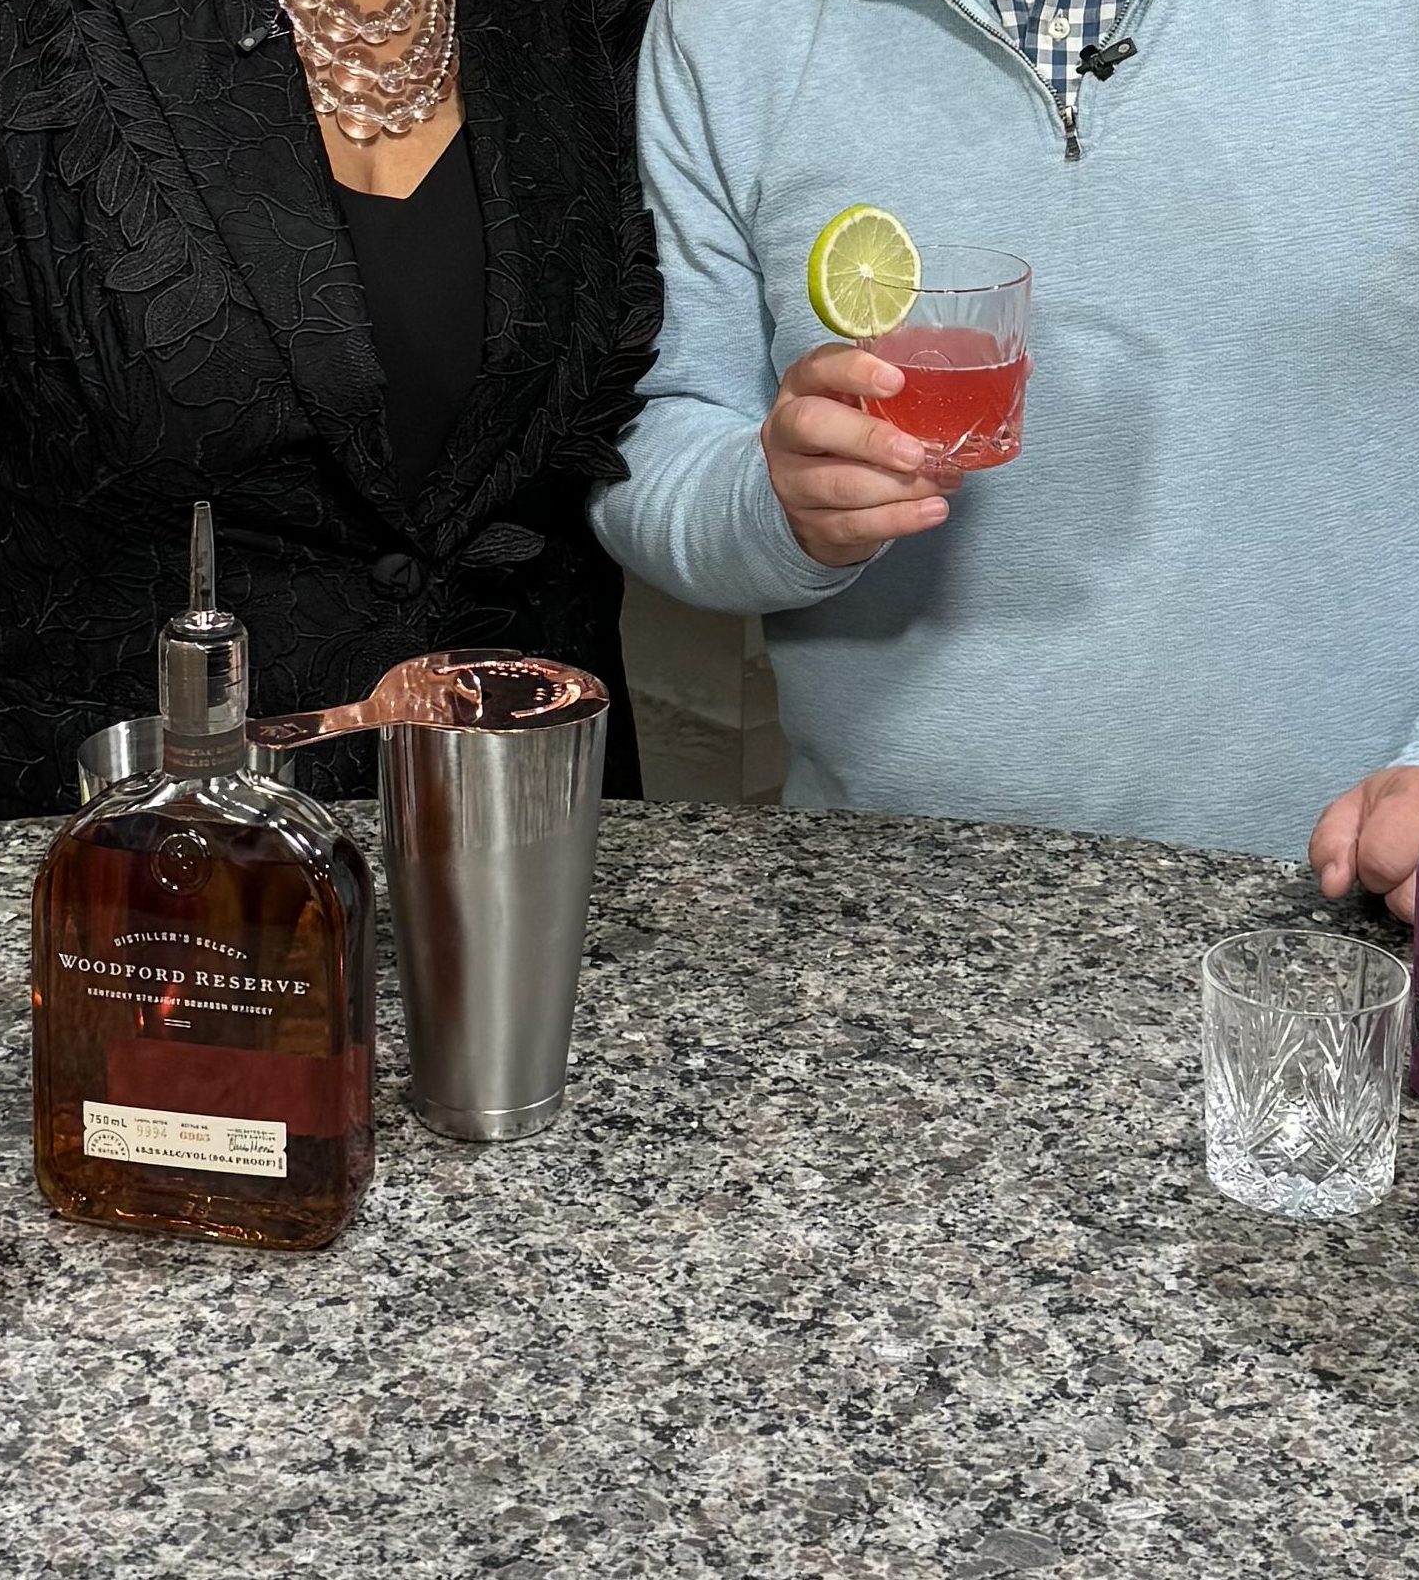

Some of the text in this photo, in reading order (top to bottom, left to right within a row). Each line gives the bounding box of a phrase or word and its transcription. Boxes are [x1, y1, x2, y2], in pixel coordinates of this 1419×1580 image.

[59, 953, 309, 996] WOODFORD RESERVE
[162, 1149, 207, 1161] ALC/VOL
[236, 1157, 276, 1168] PROOF)
